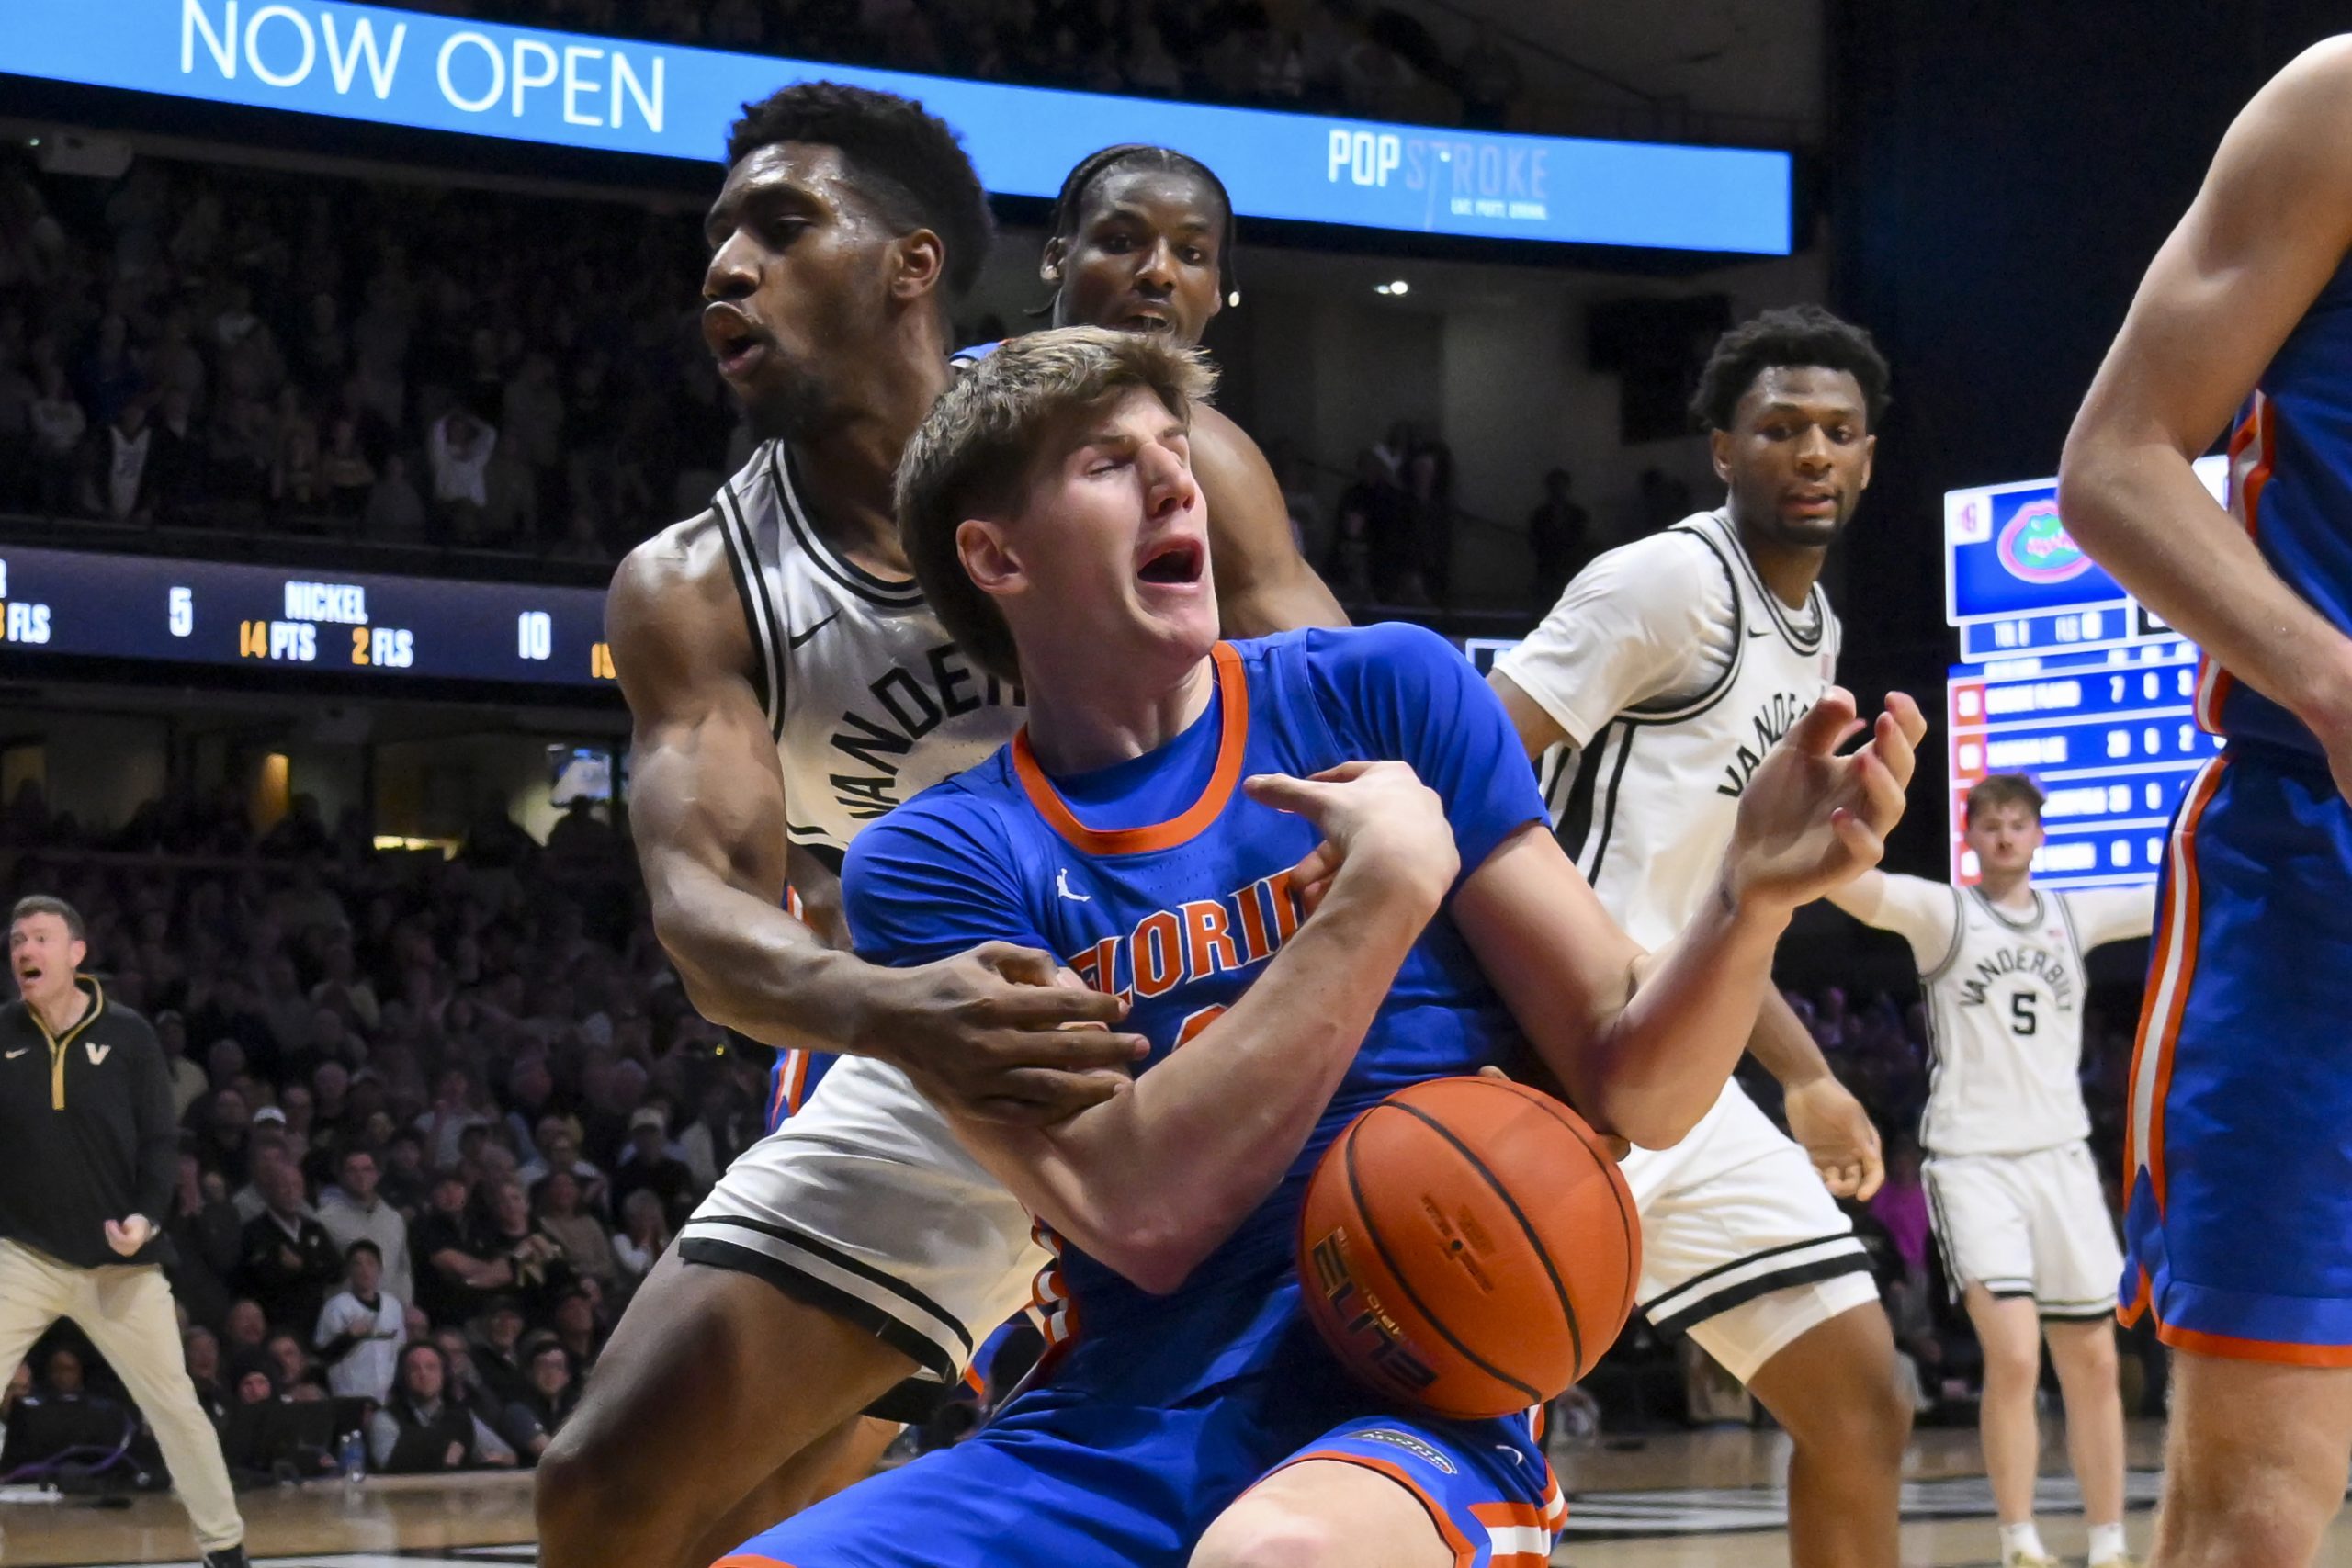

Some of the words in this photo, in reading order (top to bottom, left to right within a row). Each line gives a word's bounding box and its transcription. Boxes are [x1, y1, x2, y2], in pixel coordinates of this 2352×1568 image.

[182, 0, 406, 100] NOW
[436, 31, 664, 134] OPEN
[7, 603, 51, 643] FLS
[169, 587, 193, 637] 5
[285, 581, 368, 624] NICKEL
[241, 621, 266, 658] 14
[270, 621, 316, 661] PTS
[353, 627, 369, 664] 2
[372, 628, 413, 668] FLS
[518, 611, 551, 660] 10
[1716, 692, 1809, 798] VANDE
[1959, 946, 2072, 1012] VANDERBILT
[2011, 991, 2037, 1036] 5
[85, 1042, 111, 1066] V
[1312, 1231, 1438, 1389] ELITE
